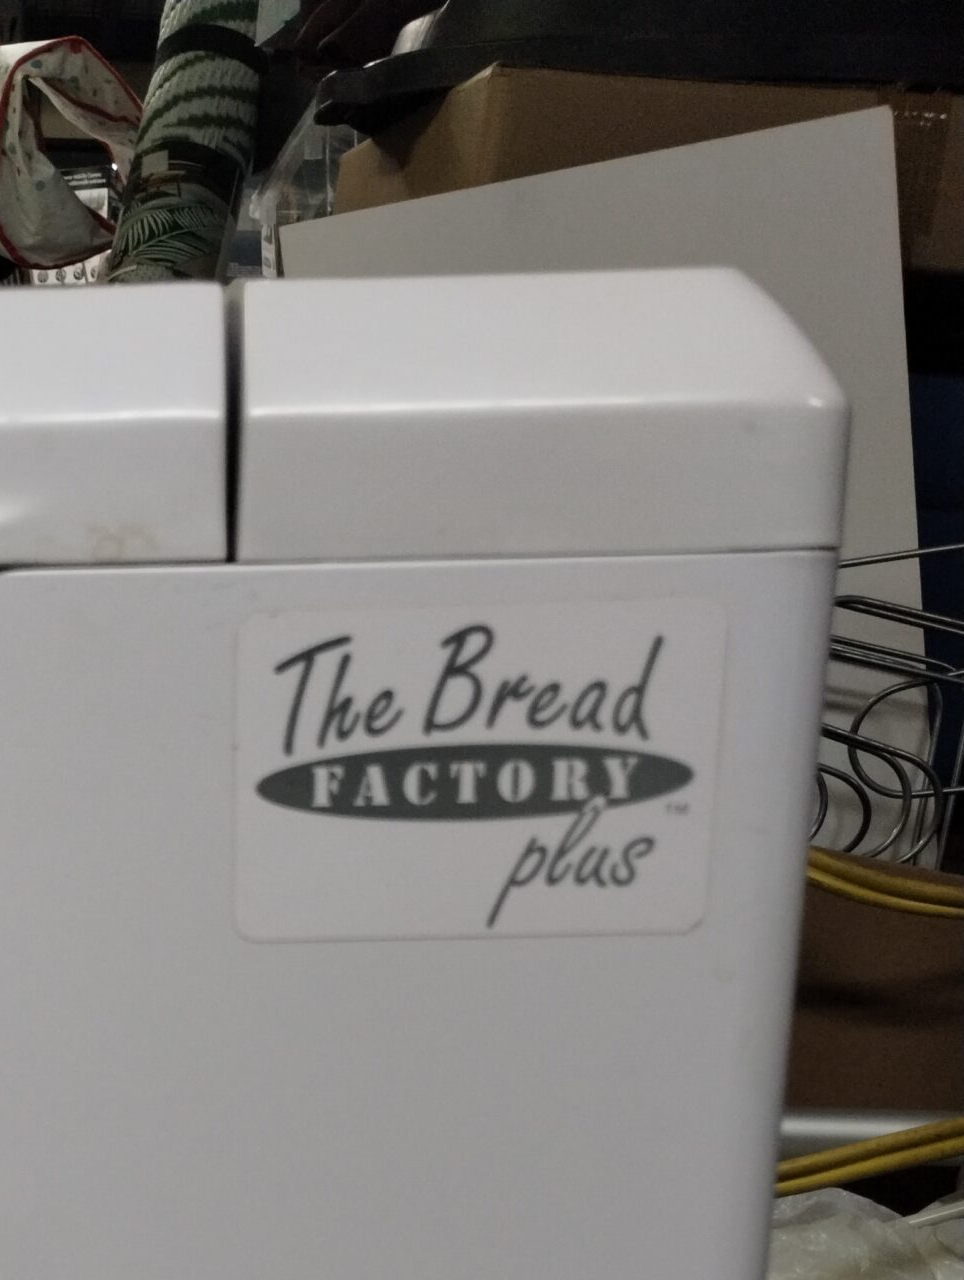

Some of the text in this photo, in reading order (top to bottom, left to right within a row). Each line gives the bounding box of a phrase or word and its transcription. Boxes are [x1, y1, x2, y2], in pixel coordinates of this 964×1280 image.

[273, 623, 665, 756] The Bread
[309, 756, 639, 808] FACTORY
[485, 797, 657, 929] plus
